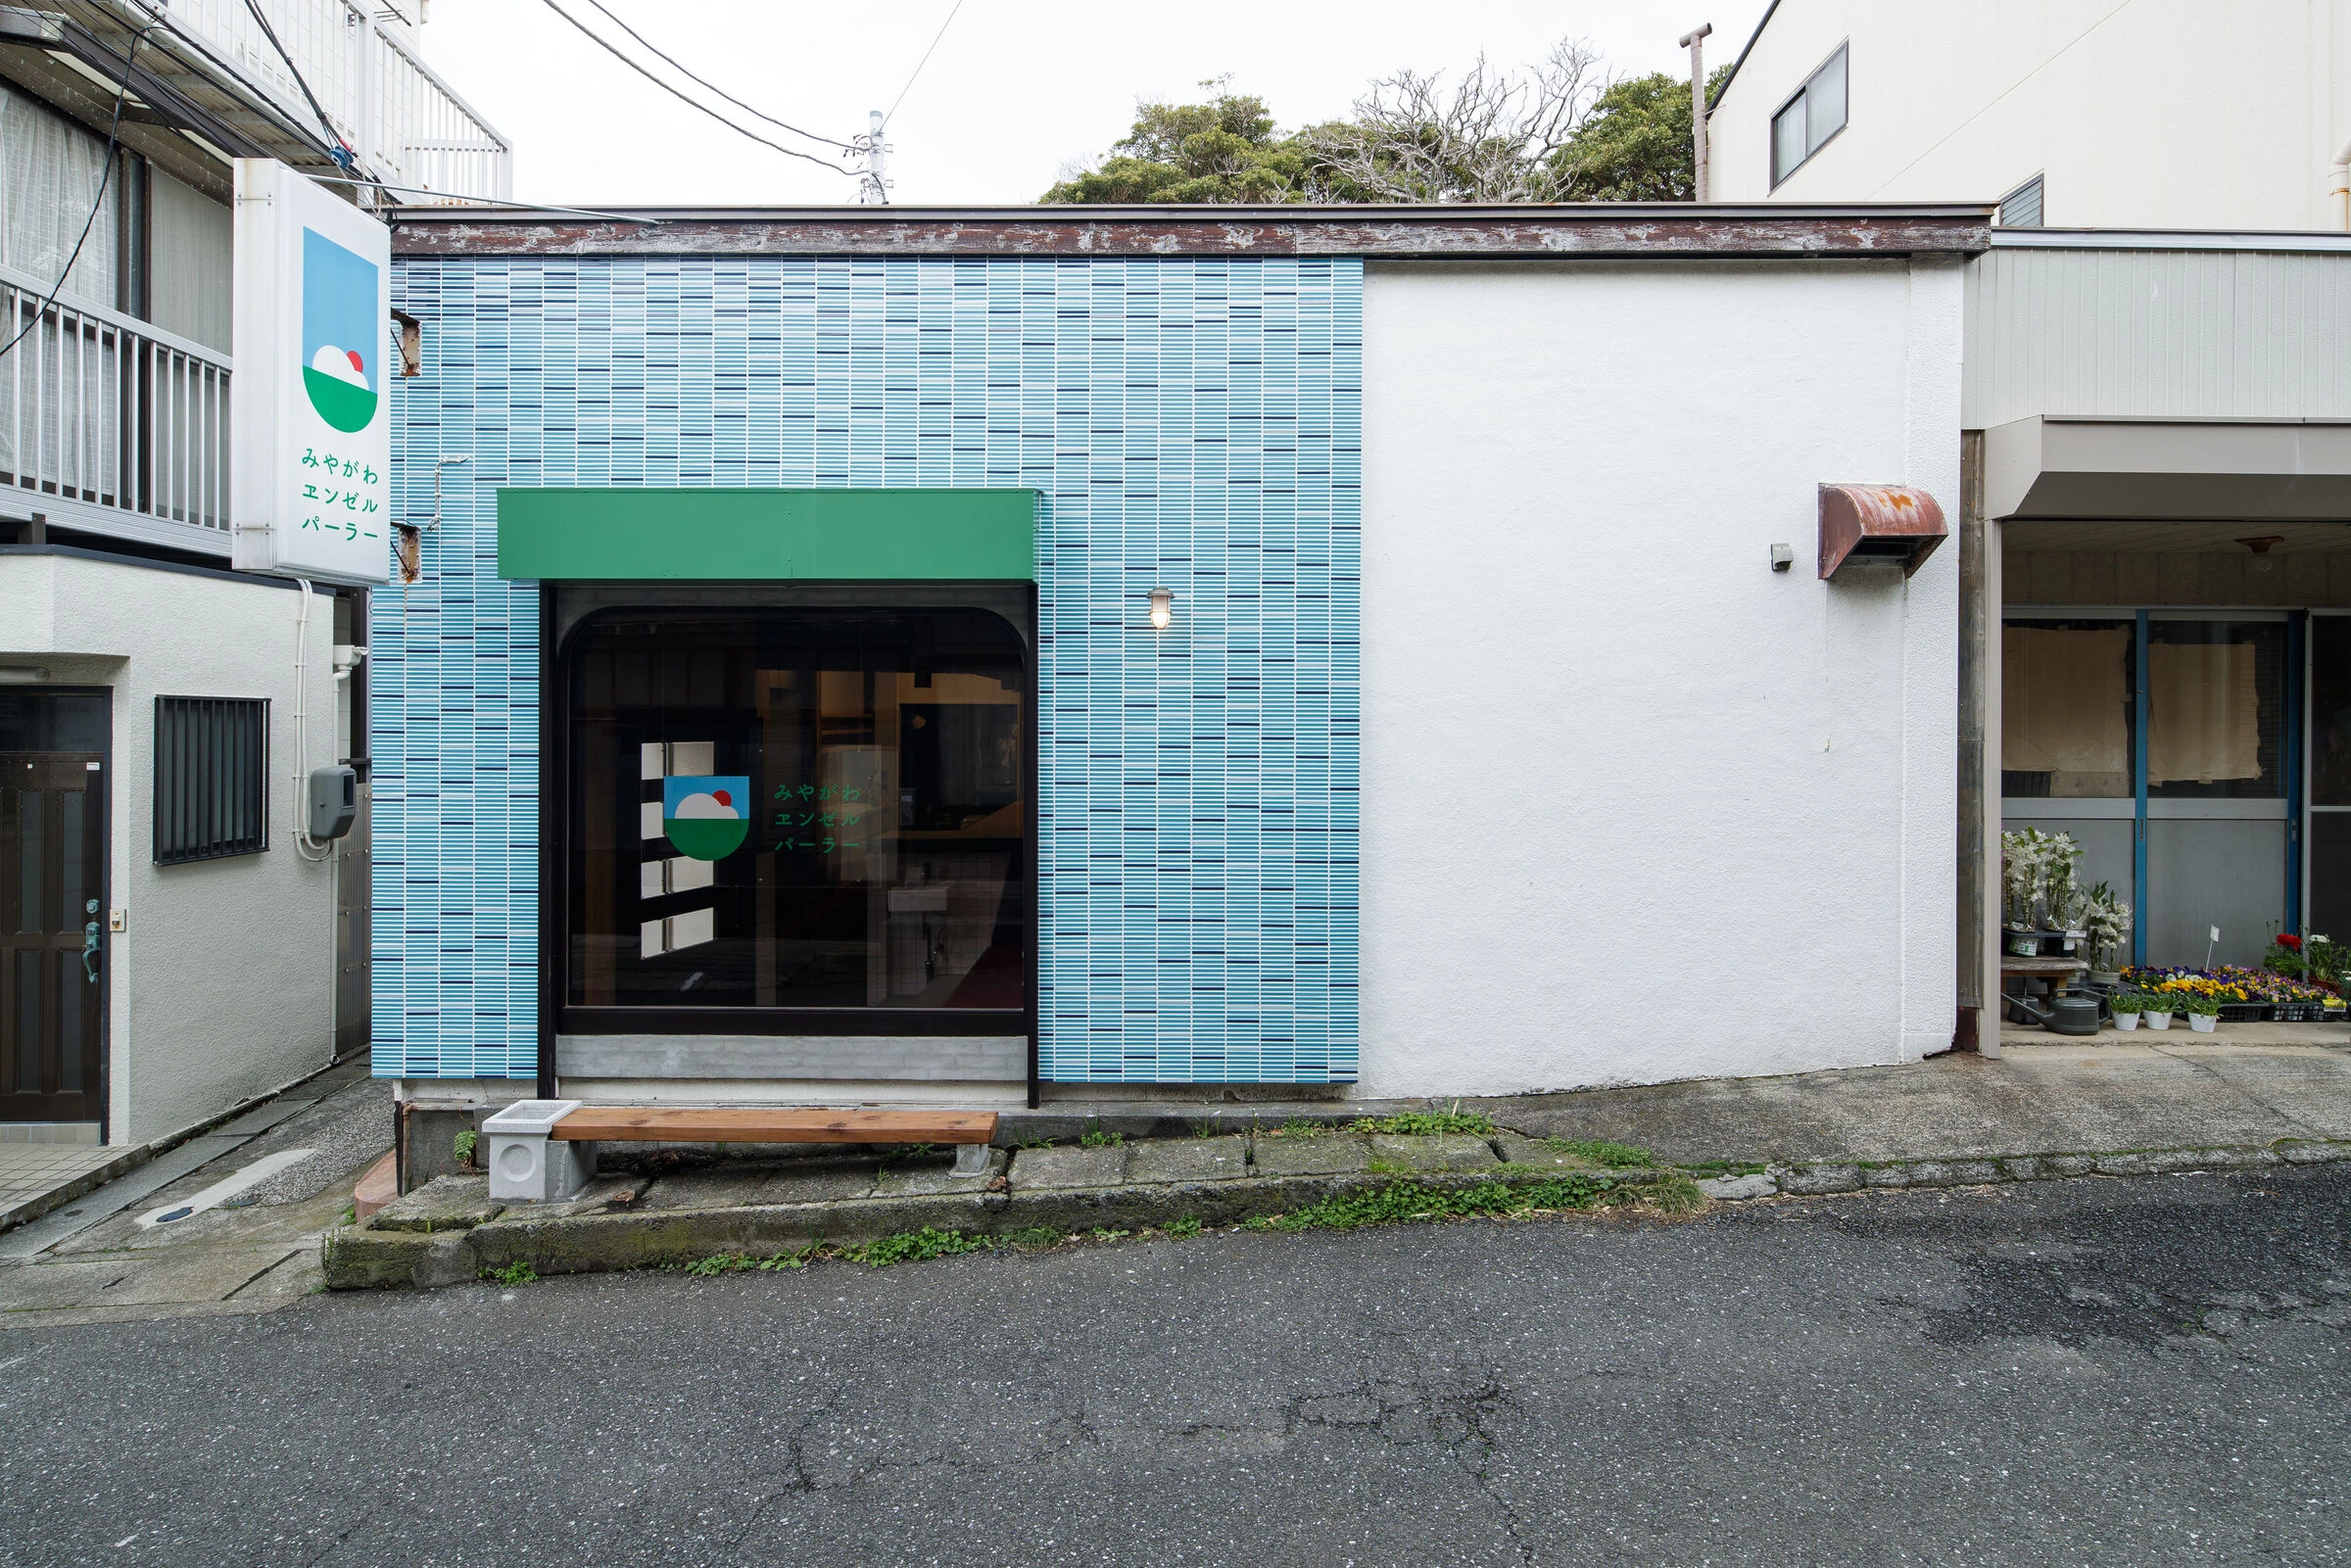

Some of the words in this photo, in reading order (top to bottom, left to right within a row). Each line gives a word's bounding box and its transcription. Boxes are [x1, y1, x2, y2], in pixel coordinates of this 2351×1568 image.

[302, 448, 379, 485] みやがわ
[302, 515, 378, 542] パーラー
[774, 784, 861, 802] みやがわ
[775, 837, 860, 854] パーラー
